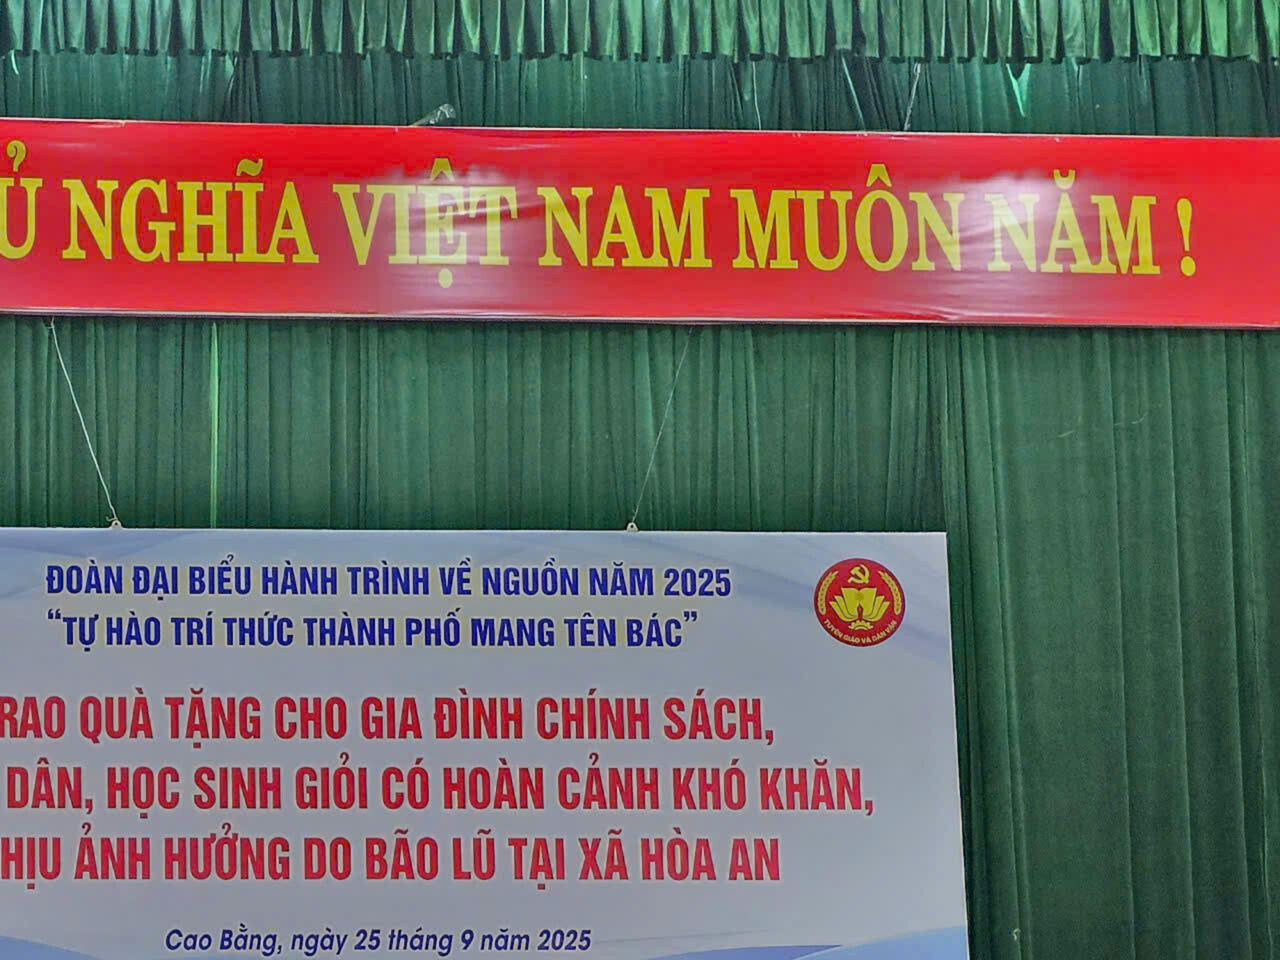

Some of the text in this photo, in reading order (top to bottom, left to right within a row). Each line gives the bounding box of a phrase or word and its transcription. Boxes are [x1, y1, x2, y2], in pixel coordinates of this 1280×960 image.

[61, 158, 320, 264] NGHĨA
[333, 157, 518, 289] VIỆT
[537, 186, 713, 268] NAM
[731, 163, 965, 273] MUÔN
[989, 169, 1162, 277] NĂM
[1176, 198, 1197, 277] !
[46, 554, 733, 601] ĐOÀN ĐẠI BIỂU HÀNH TRÌNH VỀ NGUỒN NĂM 2025
[46, 607, 699, 652] “TỰ HÀO TRÍ THỨC THÀNH PHỐ MANG TÊN BÁC”
[79, 687, 155, 743] QUÀ
[164, 687, 261, 750] TẶNG
[274, 696, 348, 741] CHO
[360, 696, 423, 741] GIA
[433, 687, 523, 741] ĐÌNH
[536, 687, 651, 741] CHÍNH
[663, 687, 775, 748] SÁCH,
[6, 757, 94, 815] DÂN,
[107, 765, 180, 819] HỌC
[193, 765, 282, 810] SINH
[294, 751, 368, 811] GIỎI
[381, 757, 431, 811] CÓ
[442, 757, 545, 811] HOÀN
[557, 752, 660, 811] CẢNH
[672, 757, 747, 812] KHÓ
[760, 758, 875, 817] KHĂN,
[74, 822, 151, 881] ẢNH
[164, 823, 291, 881] HƯỞNG
[303, 836, 352, 881] DO
[365, 828, 439, 882] BÃO
[451, 829, 496, 882] LŨ
[507, 836, 566, 891] TẠI
[578, 828, 630, 882] XÃ
[641, 826, 716, 882] HÒA
[727, 837, 781, 882] AN
[164, 921, 593, 957] Cao Bằng, ngày 25 tháng 9 năm 2025
